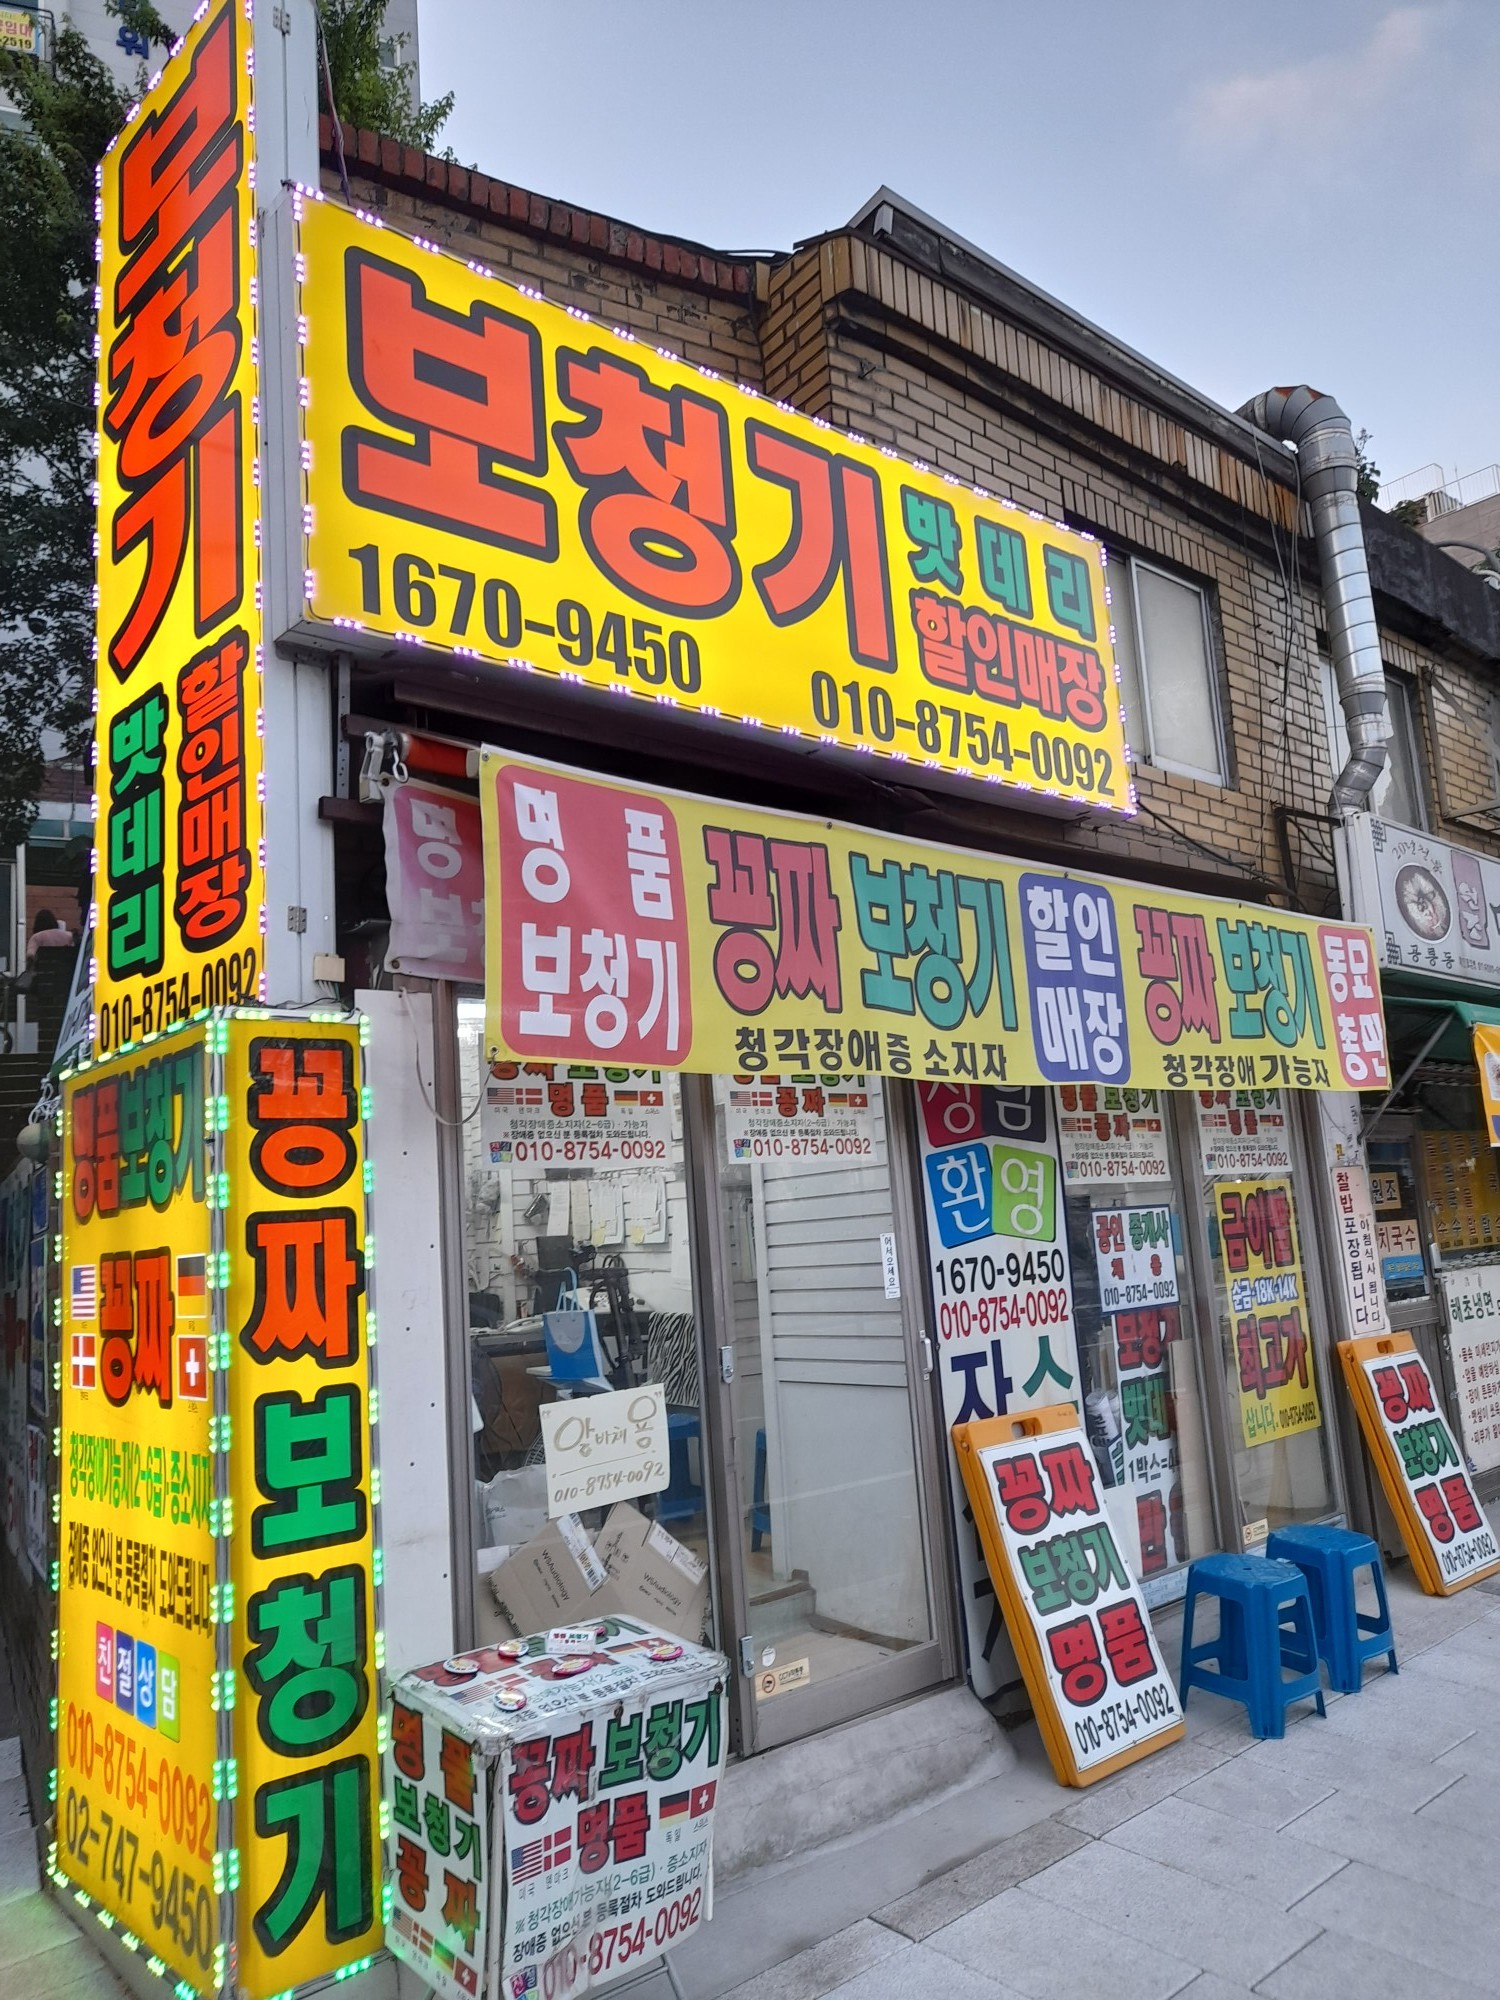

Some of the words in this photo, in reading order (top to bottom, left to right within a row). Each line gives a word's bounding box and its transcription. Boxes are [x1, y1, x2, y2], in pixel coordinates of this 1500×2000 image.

[103, 2, 244, 684] 보청기
[341, 245, 897, 674] 보청기
[349, 542, 701, 694] 1670-9450
[909, 588, 1107, 732] 할인매장
[811, 671, 1116, 797] 010-8754-0092
[108, 683, 168, 982] 밧데리
[174, 624, 251, 953] 할인매장
[513, 782, 674, 920] 명품
[702, 823, 842, 1016] 꽁짜
[848, 851, 1018, 1031] 보청기
[1025, 884, 1117, 977] 할인
[1133, 903, 1222, 1046] 꽁짜
[1216, 917, 1326, 1050] 보청기
[519, 922, 678, 1052] 보청기
[1035, 986, 1123, 1077] 매장
[924, 1039, 1007, 1081] 소지자
[1163, 1054, 1256, 1088] 청각장애
[1260, 1054, 1331, 1088] 가능자
[119, 1043, 207, 1213] 보청기
[515, 1140, 666, 1161] 010-8754-0092
[753, 1137, 871, 1156] 010-8754-0092
[1080, 1160, 1166, 1177] 010-8754-0092
[1217, 1152, 1288, 1168] 010-8754-0092
[240, 1037, 364, 1370] 꽁짜
[936, 1151, 1044, 1236] 환영
[936, 1249, 1065, 1296] 1670-9450
[939, 1288, 1068, 1339] 010-8754-0092
[1104, 1280, 1175, 1306] 010-8754-0092
[99, 1246, 174, 1408] 꽁짜
[1372, 1359, 1435, 1423] 꽁짜
[554, 1459, 665, 1503] 010-8754-0092
[992, 1442, 1100, 1536] 꽁짜
[1393, 1417, 1460, 1480] 보청기
[1414, 1472, 1483, 1543] 명품
[1017, 1521, 1130, 1616] 보청기
[243, 1382, 374, 1958] 보청기
[1045, 1597, 1157, 1707] 명품
[508, 1721, 596, 1825] 꽁짜
[599, 1689, 723, 1791] 보청기
[1074, 1683, 1174, 1755] 010-8754-0092
[67, 1702, 212, 1865] 010-8754-0092
[393, 1775, 482, 1882] 보청기
[576, 1791, 650, 1875] 명품
[64, 1786, 213, 1971] 02-747-9450
